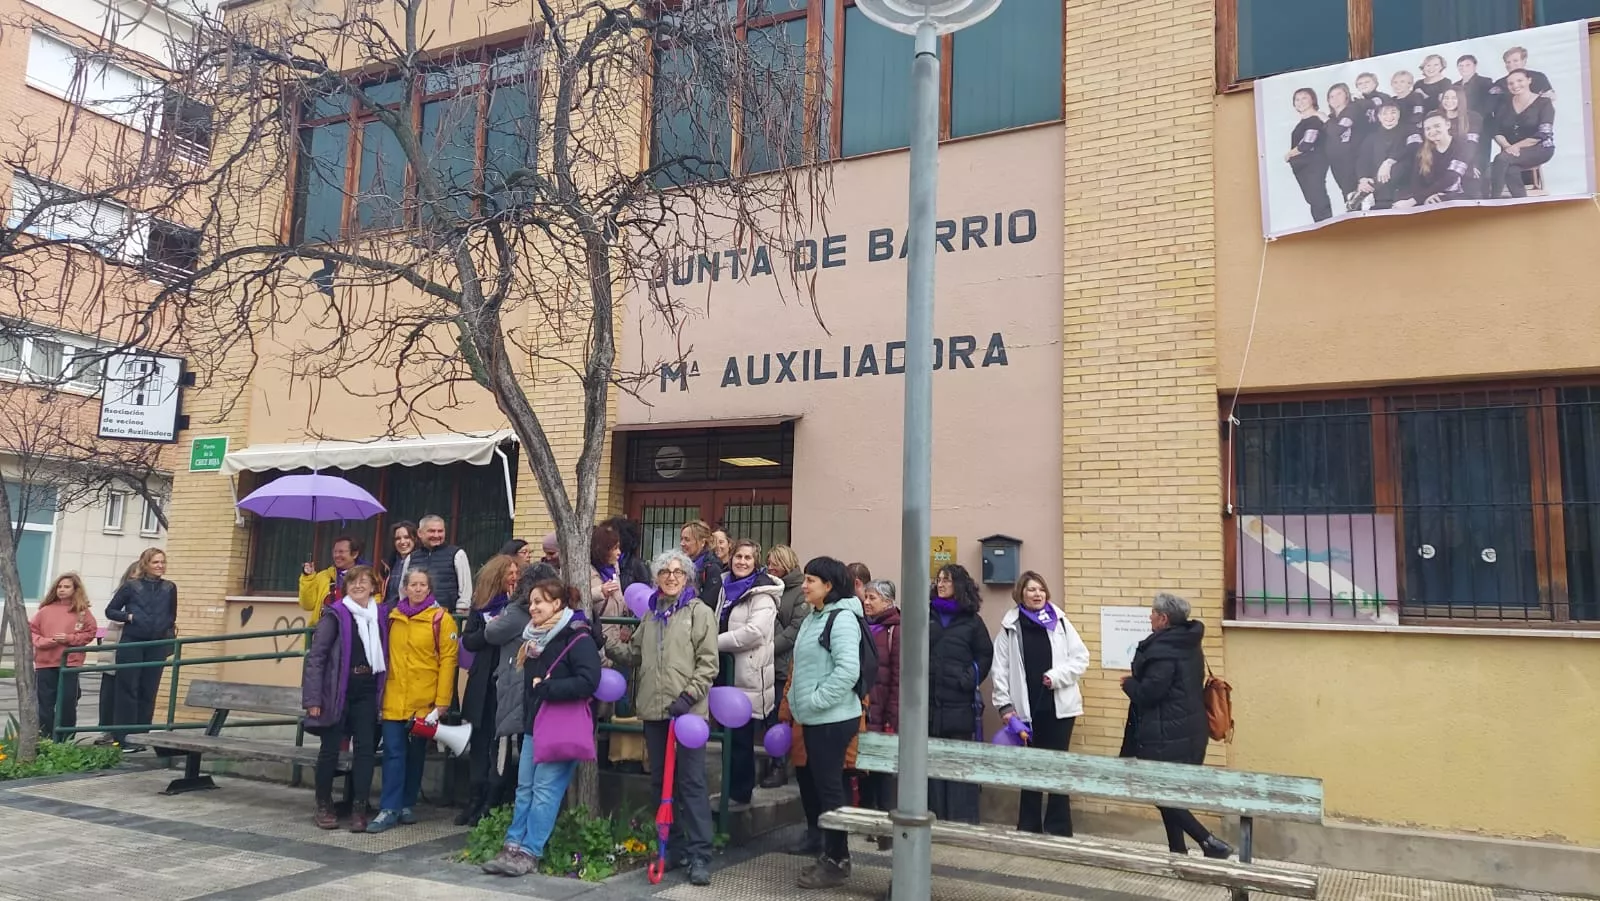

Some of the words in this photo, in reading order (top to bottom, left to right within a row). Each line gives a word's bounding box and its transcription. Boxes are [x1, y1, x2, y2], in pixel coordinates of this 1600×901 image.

[648, 245, 773, 289] JUNTA
[793, 234, 847, 273] DE
[116, 418, 144, 426] vecinos
[127, 428, 173, 437] Auxiliadora
